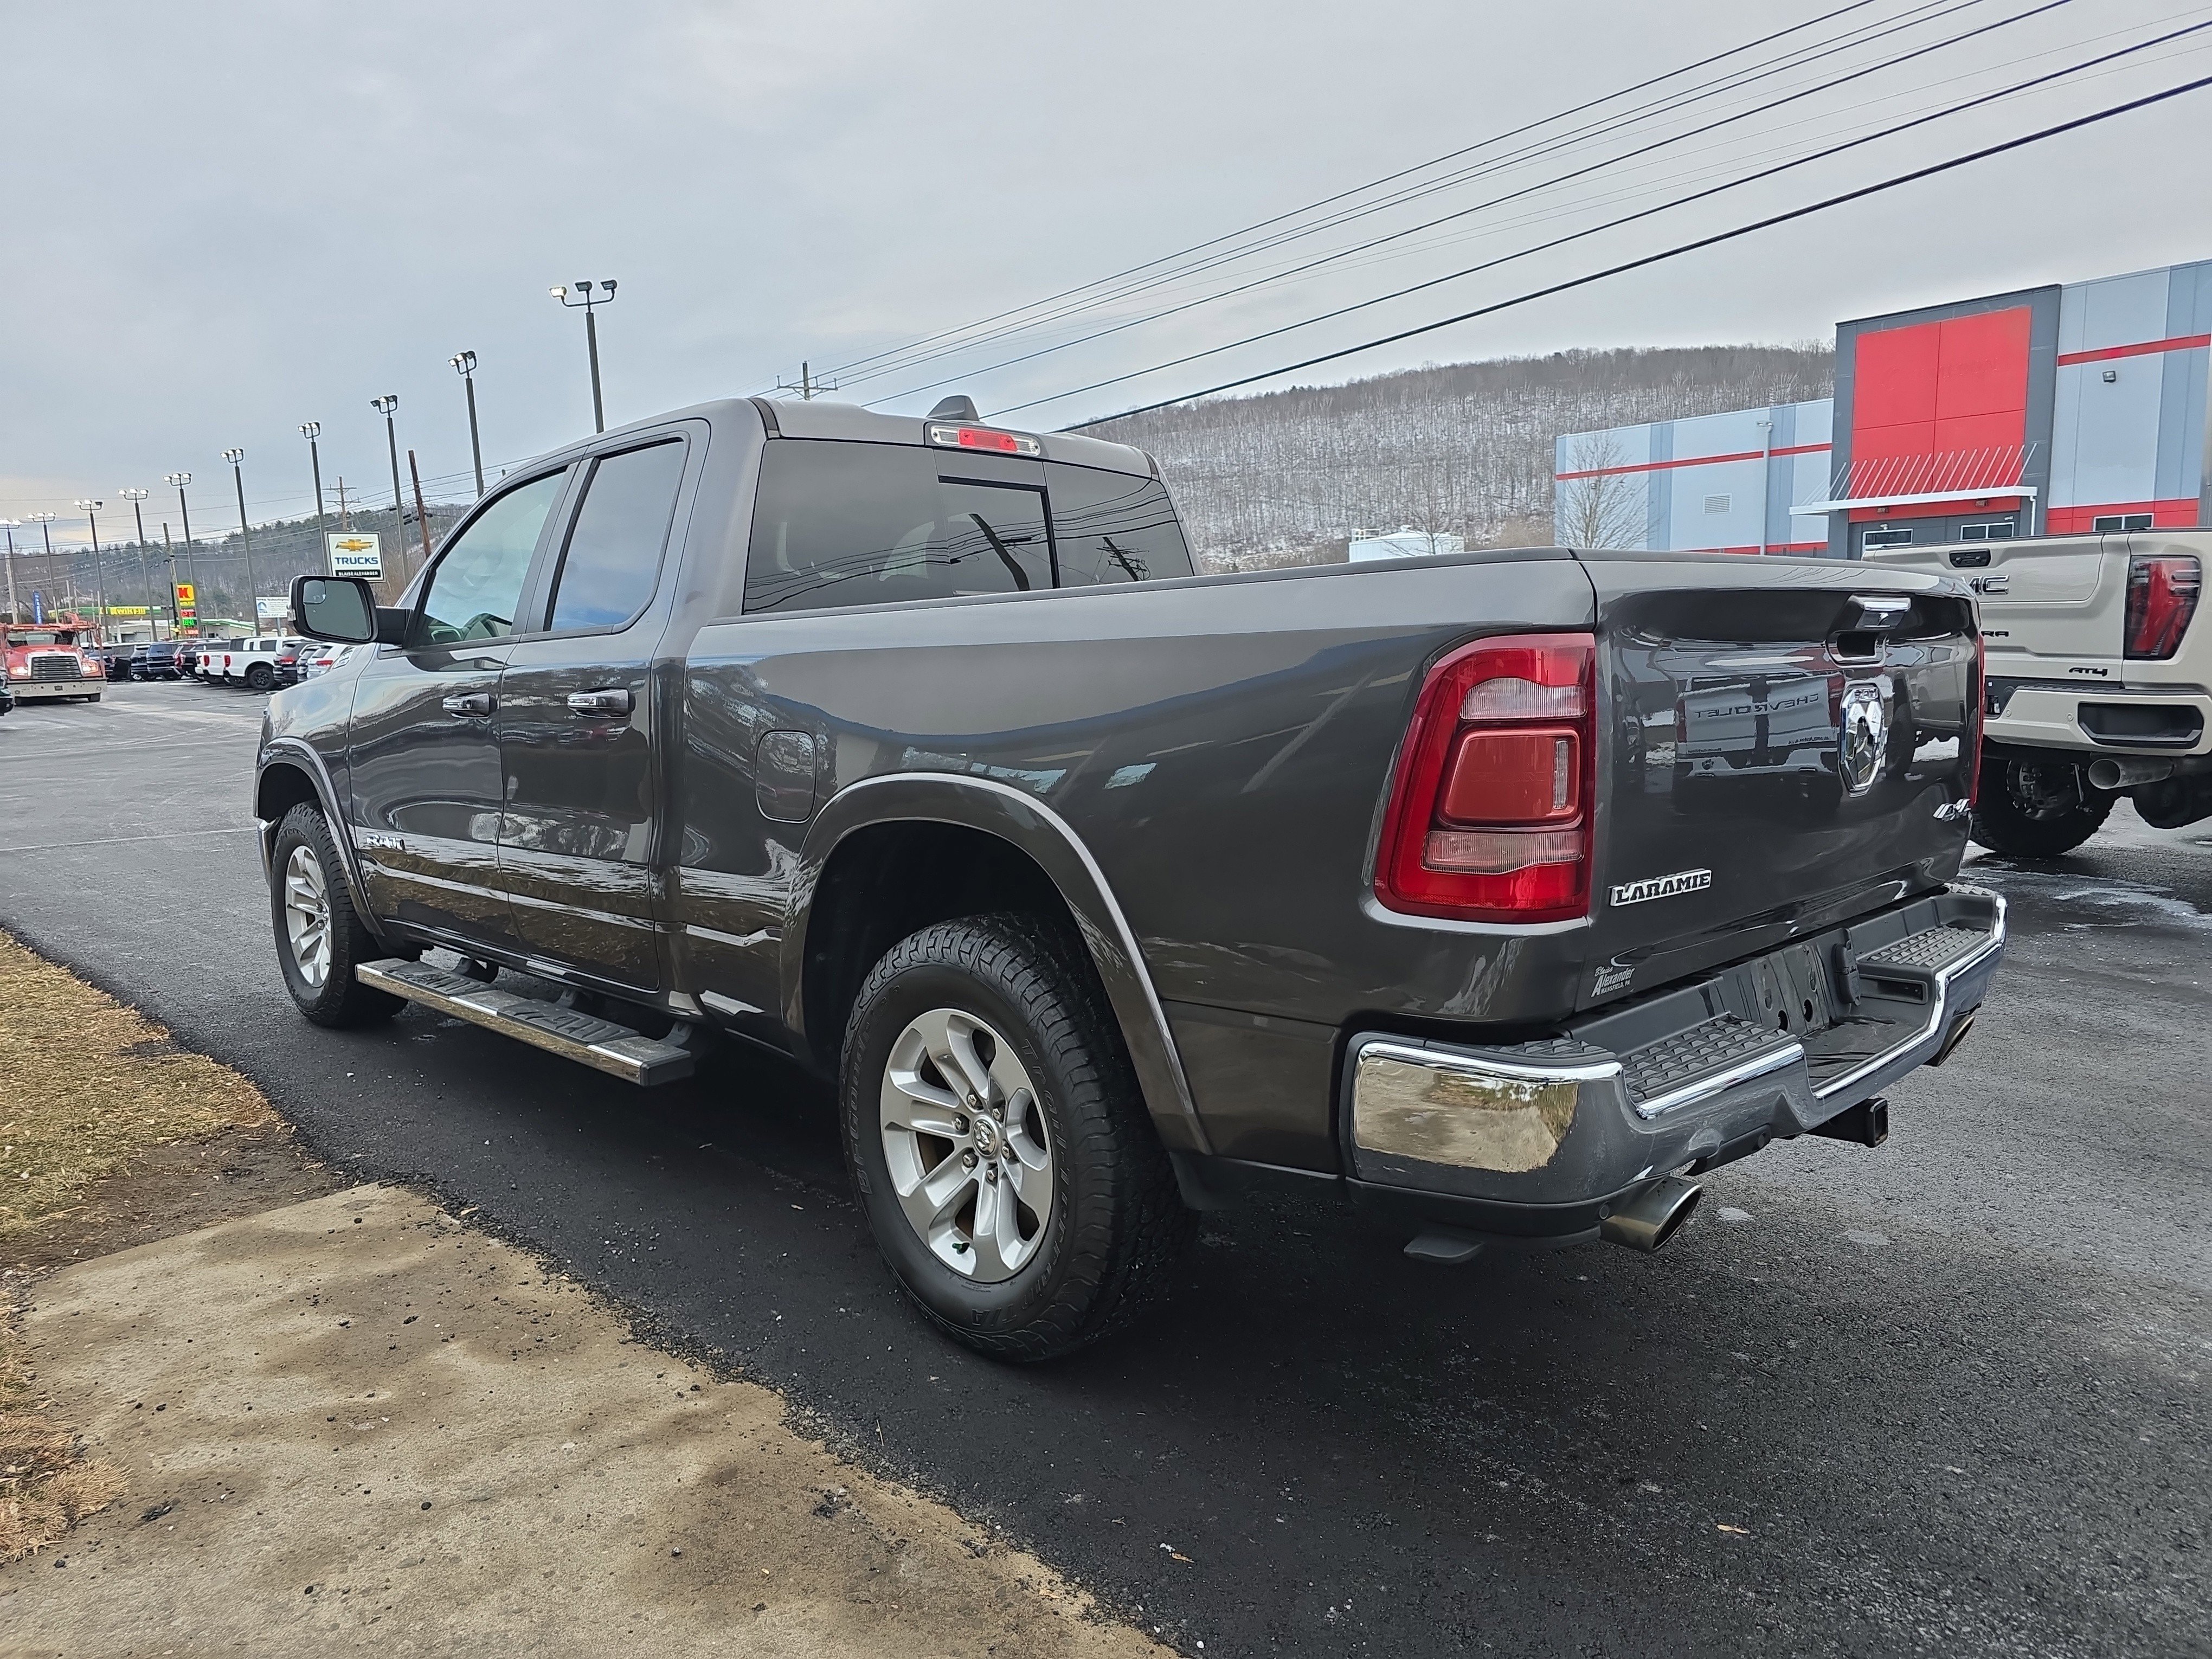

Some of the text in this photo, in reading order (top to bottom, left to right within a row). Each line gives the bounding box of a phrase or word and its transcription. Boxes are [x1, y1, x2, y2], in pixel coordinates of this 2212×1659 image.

[178, 587, 190, 599] K
[1962, 574, 2010, 595] MC
[2068, 667, 2108, 677] AT4
[366, 833, 406, 851] RAM
[1610, 869, 1712, 906] LARAMIE
[1591, 967, 1636, 998] Alexander
